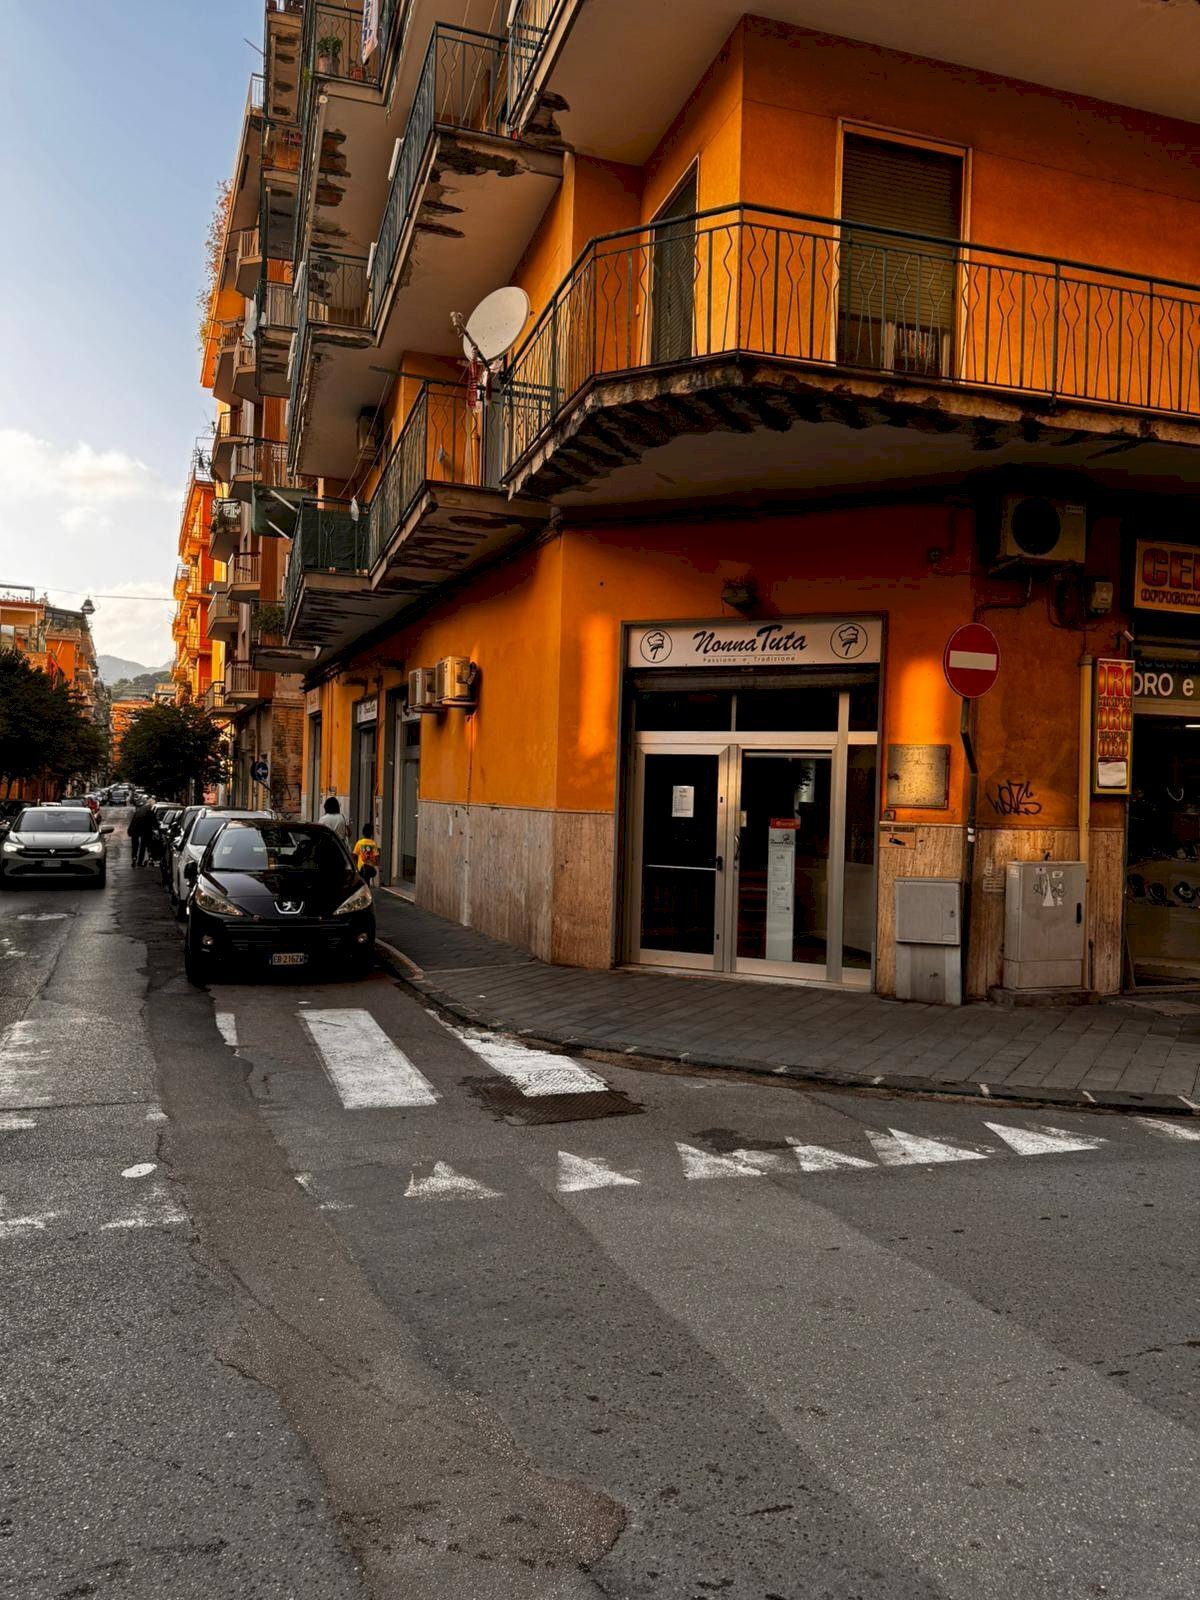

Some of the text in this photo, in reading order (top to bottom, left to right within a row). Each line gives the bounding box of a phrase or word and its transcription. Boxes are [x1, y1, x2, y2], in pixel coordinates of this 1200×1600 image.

[1142, 547, 1200, 590] CE
[753, 655, 796, 663] Tradizione
[1182, 678, 1195, 697] e
[1097, 707, 1132, 731] ORO
[1098, 739, 1129, 757] ORO
